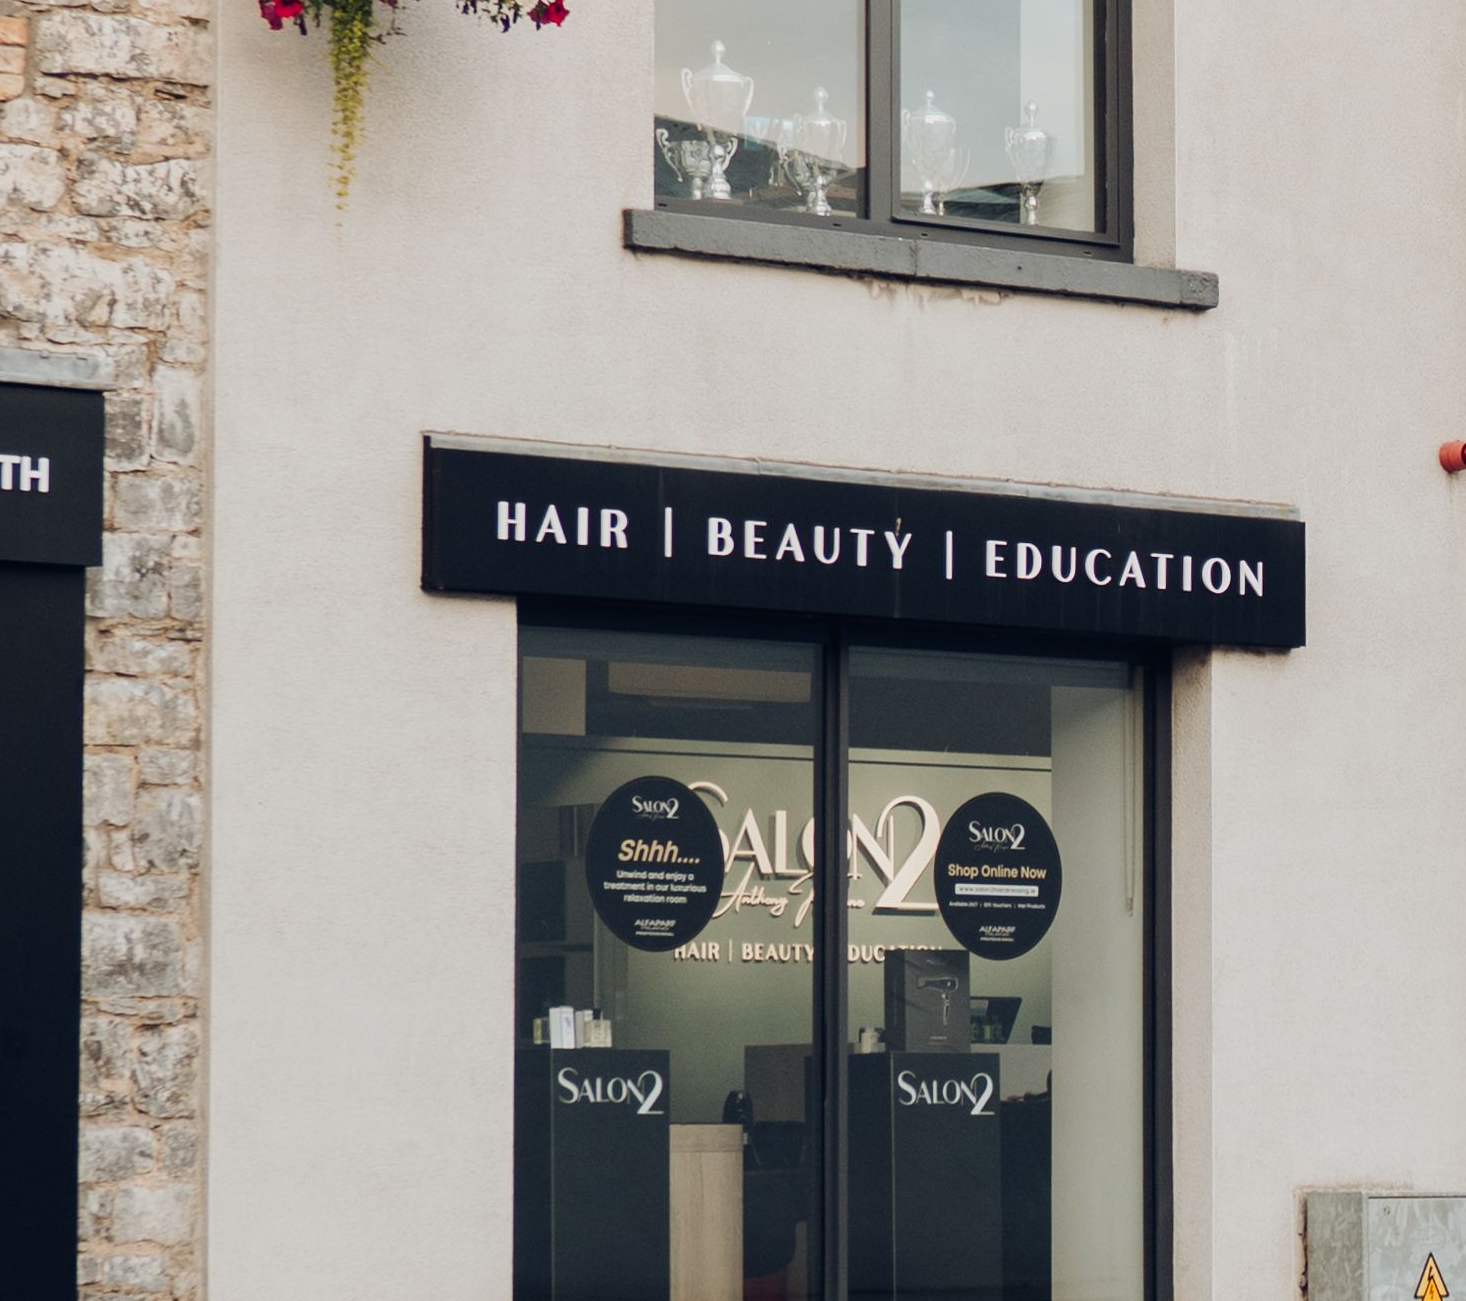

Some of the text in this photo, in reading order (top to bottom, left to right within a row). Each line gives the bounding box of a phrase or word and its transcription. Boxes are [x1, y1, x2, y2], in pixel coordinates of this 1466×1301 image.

[496, 500, 629, 549] HAIR
[707, 516, 913, 570] BEAUTY
[985, 539, 1264, 597] EDUCATION
[648, 871, 665, 880] and
[665, 871, 688, 883] enjoy
[947, 863, 1047, 880] Shop Online Now
[655, 884, 669, 892] our
[674, 941, 721, 962] HAIR
[741, 942, 814, 963] BEAUTY
